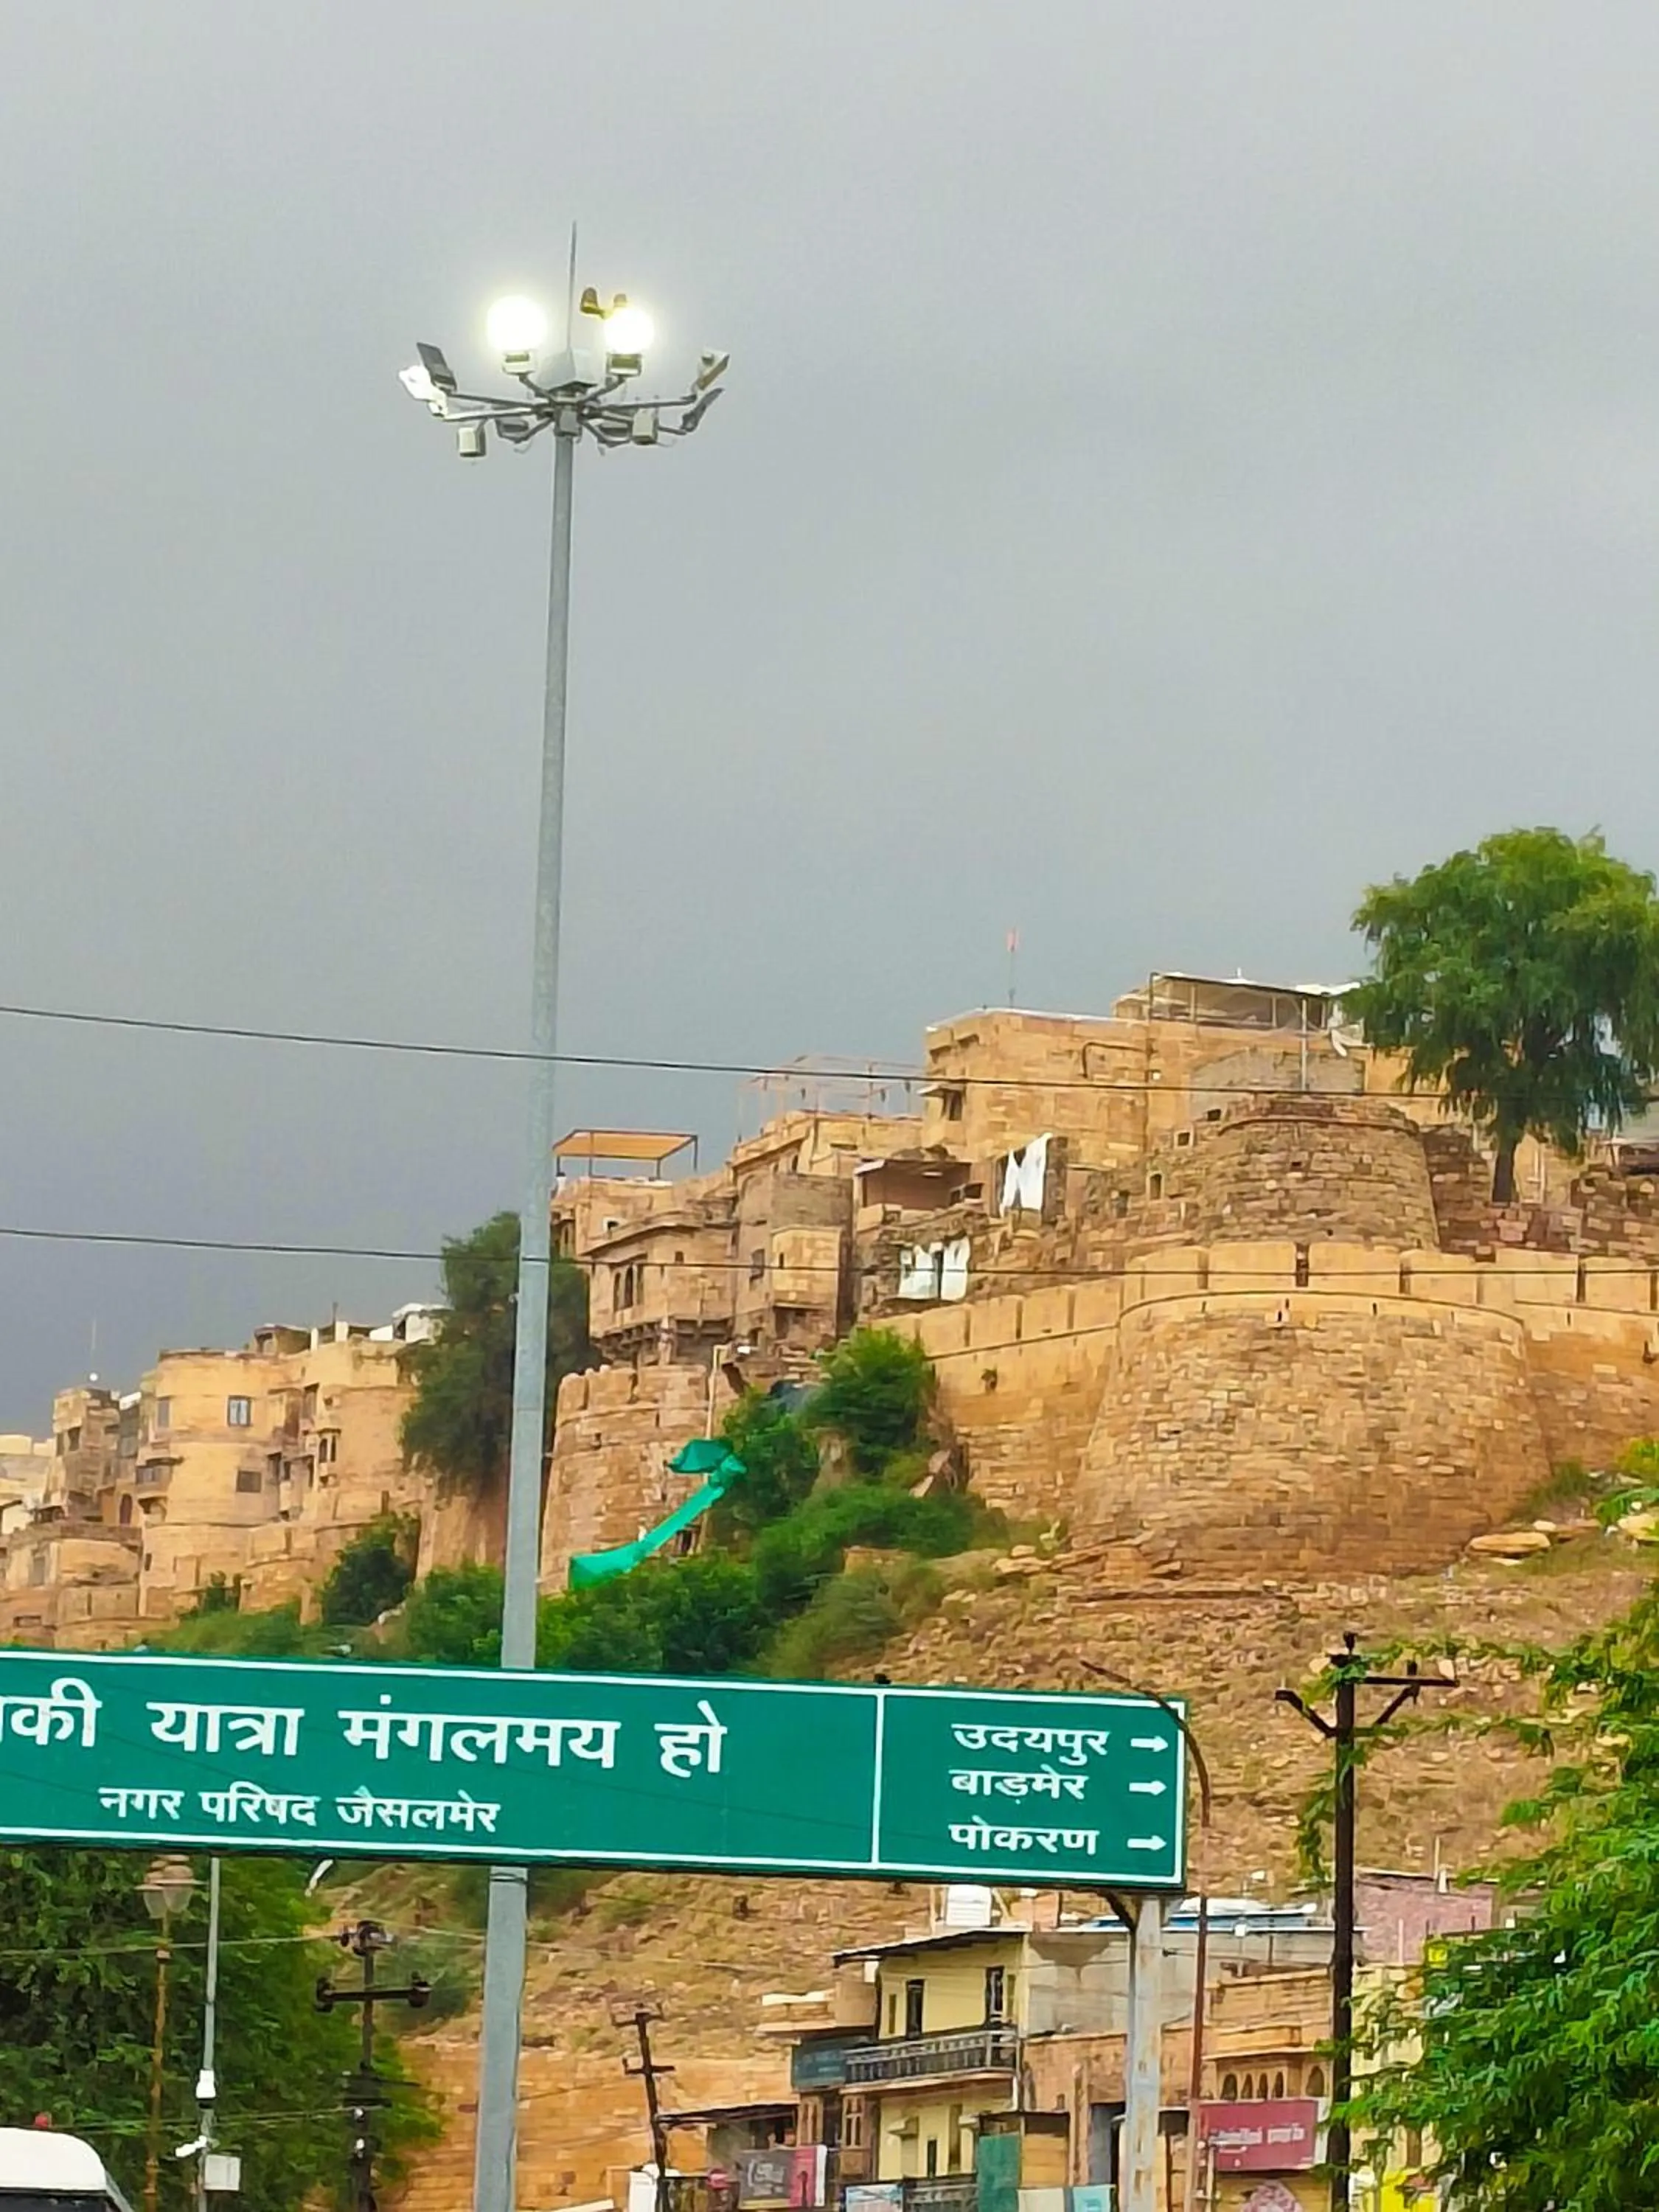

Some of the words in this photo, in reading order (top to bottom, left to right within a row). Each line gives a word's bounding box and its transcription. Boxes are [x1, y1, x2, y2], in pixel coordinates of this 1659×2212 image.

[0, 1677, 102, 1747] की
[147, 1702, 305, 1756] यात्रा
[338, 1694, 622, 1769] मंगलमय
[654, 1700, 728, 1778] हो
[951, 1723, 1109, 1765] उदयपुर
[949, 1763, 1088, 1804] बाड़मेर
[98, 1787, 184, 1820] नगर
[199, 1781, 320, 1826] परिषद
[335, 1786, 501, 1832] जैसलमेर
[948, 1815, 1099, 1855] पोकरण
